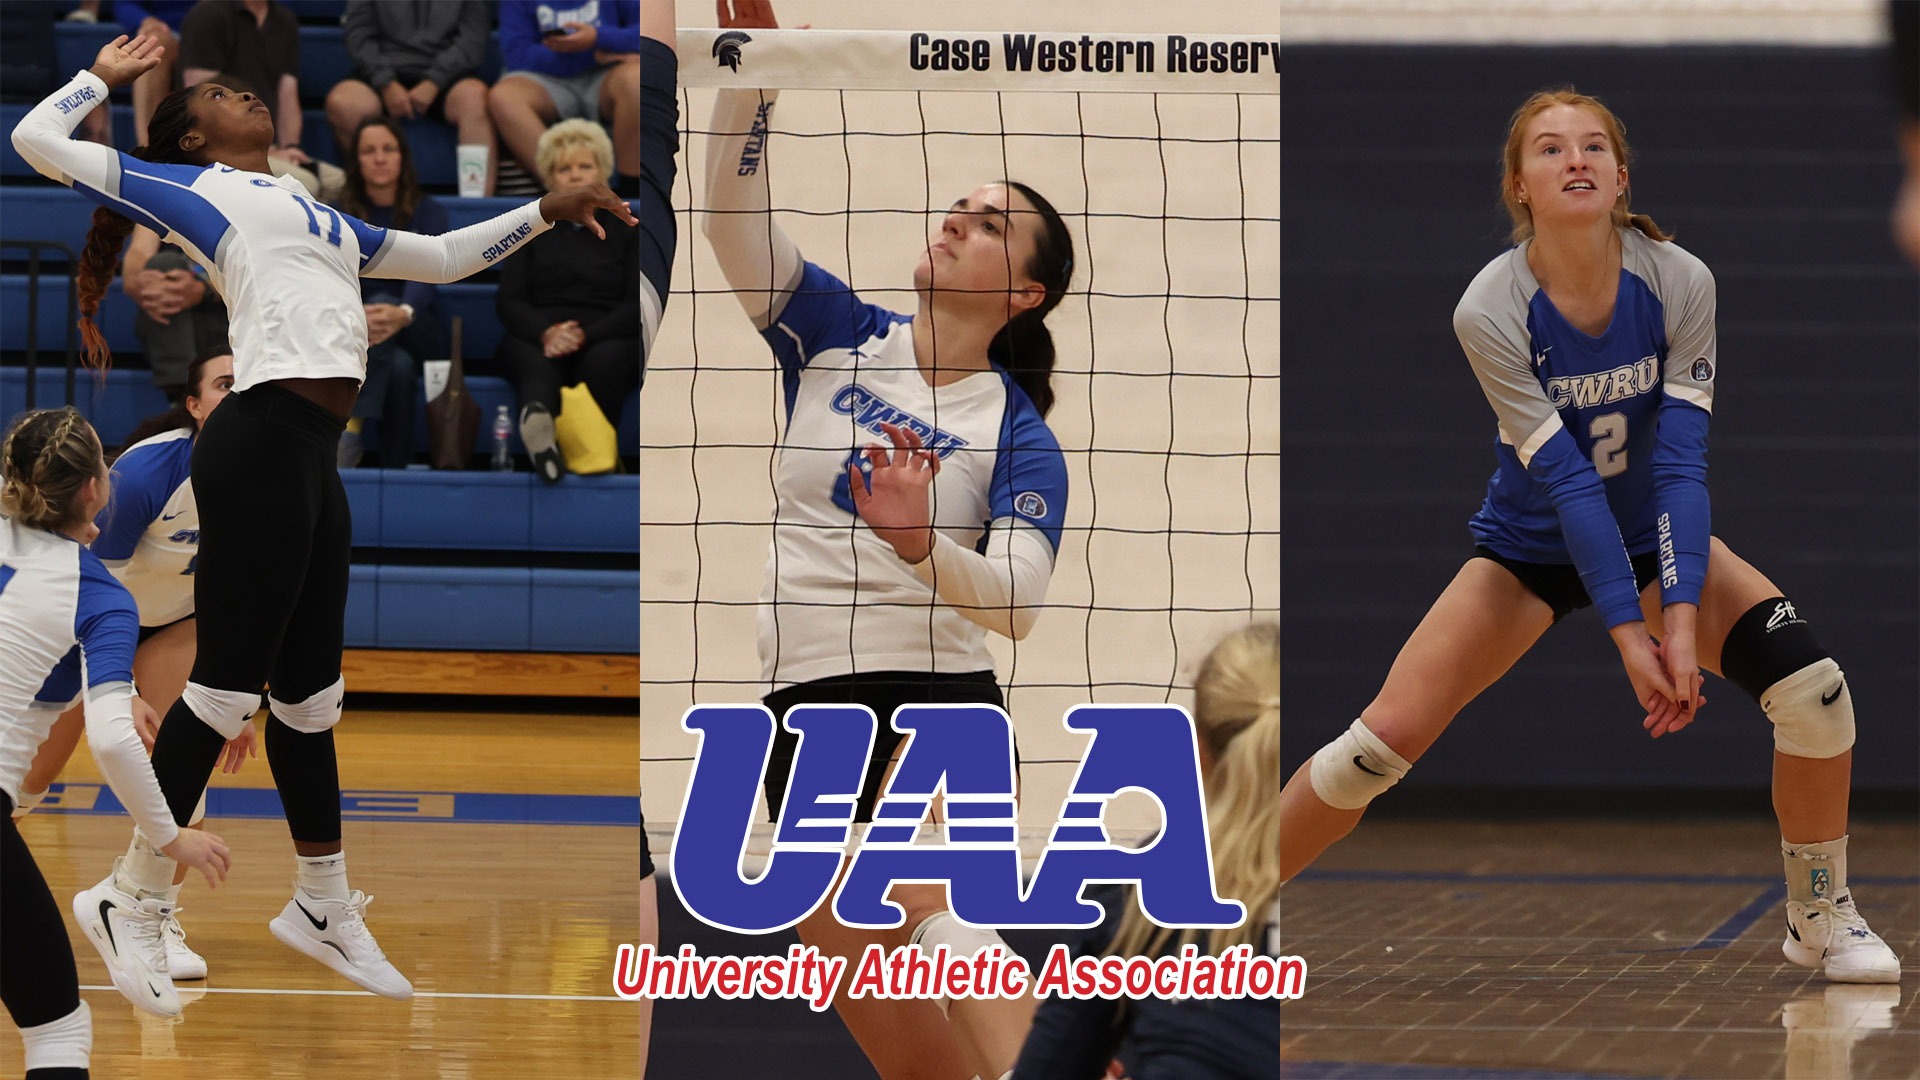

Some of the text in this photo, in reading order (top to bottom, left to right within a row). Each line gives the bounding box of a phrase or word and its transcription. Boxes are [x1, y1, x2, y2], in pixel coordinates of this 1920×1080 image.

[909, 33, 990, 71] Case
[1002, 34, 1155, 72] Western
[54, 85, 97, 115] SPARTANS
[292, 194, 342, 249] 17
[482, 222, 532, 262] SPARTANS
[1547, 352, 1661, 410] CWRU
[1589, 411, 1629, 479] 2
[1657, 512, 1678, 590] SPARTANS
